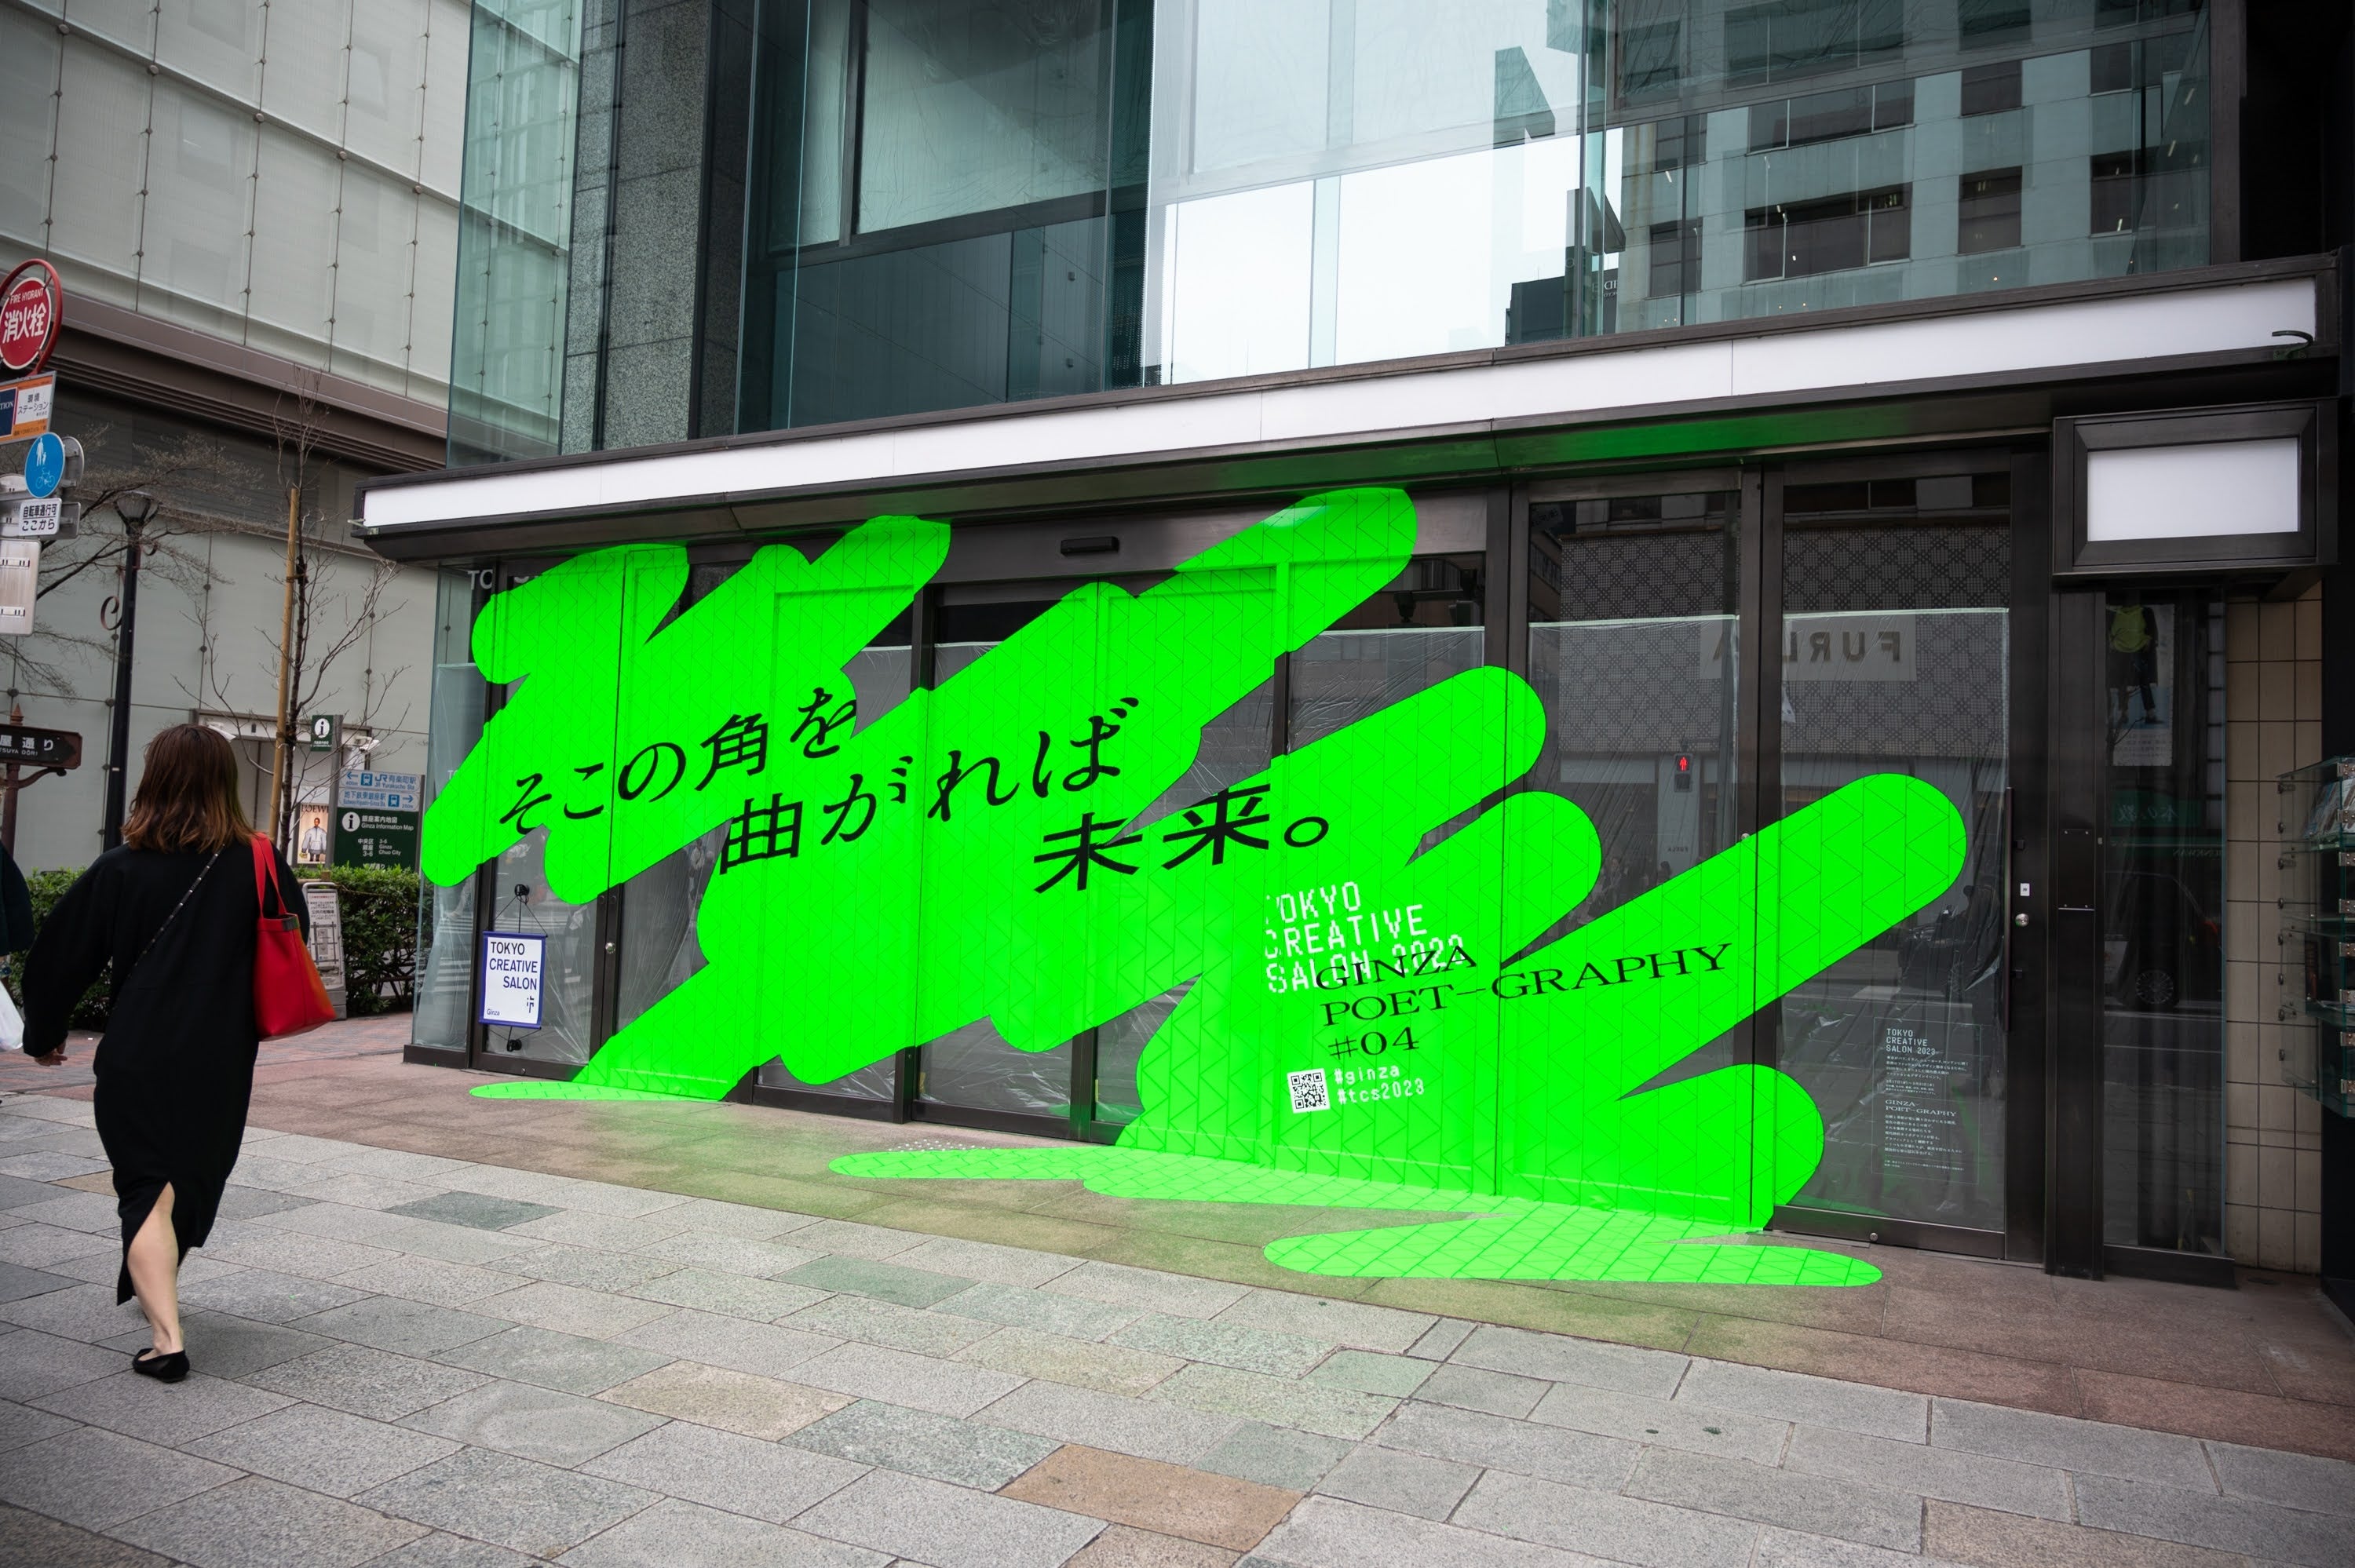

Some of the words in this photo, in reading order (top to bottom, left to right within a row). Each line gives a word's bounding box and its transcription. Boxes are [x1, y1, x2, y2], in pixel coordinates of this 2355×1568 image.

[10, 293, 20, 304] FIRE
[22, 287, 44, 301] HYDRANT
[2, 302, 46, 344] 消火栓
[23, 504, 57, 517] 自転車通行可
[22, 519, 55, 531] ここから
[499, 687, 857, 835] そこの角を
[719, 698, 1138, 875] 曲がれば
[361, 815, 398, 823] 銀座案内地図
[1035, 785, 1328, 893] 未来。
[490, 941, 525, 956] TOKYO
[489, 957, 539, 974] CREATIVE
[1265, 949, 1372, 994] SALON
[1316, 945, 1477, 990] GINZA
[502, 975, 538, 991] SALON
[487, 1008, 500, 1016] Ginza
[1886, 1028, 1914, 1037] TOKYO
[1328, 1026, 1420, 1060] #04
[1886, 1036, 1928, 1047] CREATIVE
[1886, 1045, 1913, 1054] SALON
[1917, 1046, 1936, 1056] 2023
[1333, 1064, 1400, 1085] #ginza
[1336, 1078, 1425, 1105] #tcs2023
